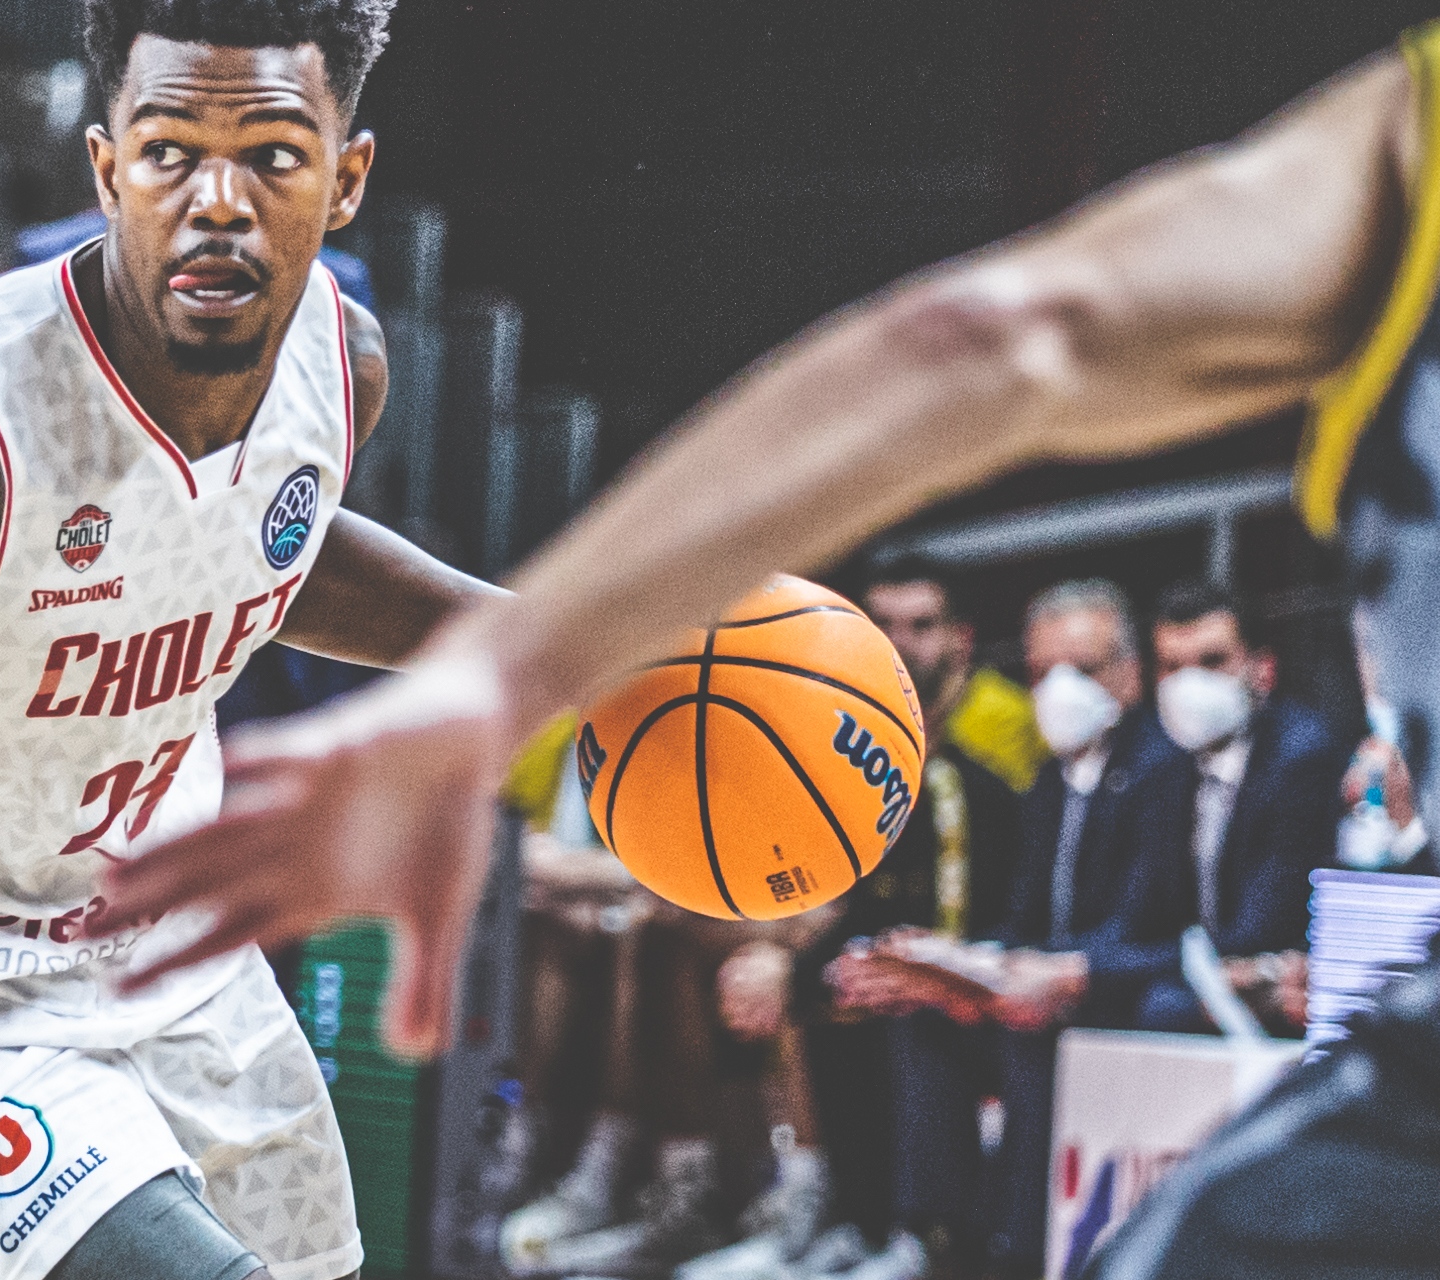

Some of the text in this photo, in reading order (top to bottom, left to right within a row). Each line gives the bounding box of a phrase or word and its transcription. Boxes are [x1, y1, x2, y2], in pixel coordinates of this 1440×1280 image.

[55, 519, 113, 551] CHOLET
[27, 575, 124, 613] SPALDING
[25, 571, 303, 718] CHOLET
[0, 1144, 108, 1254] CHEMILLÉ
